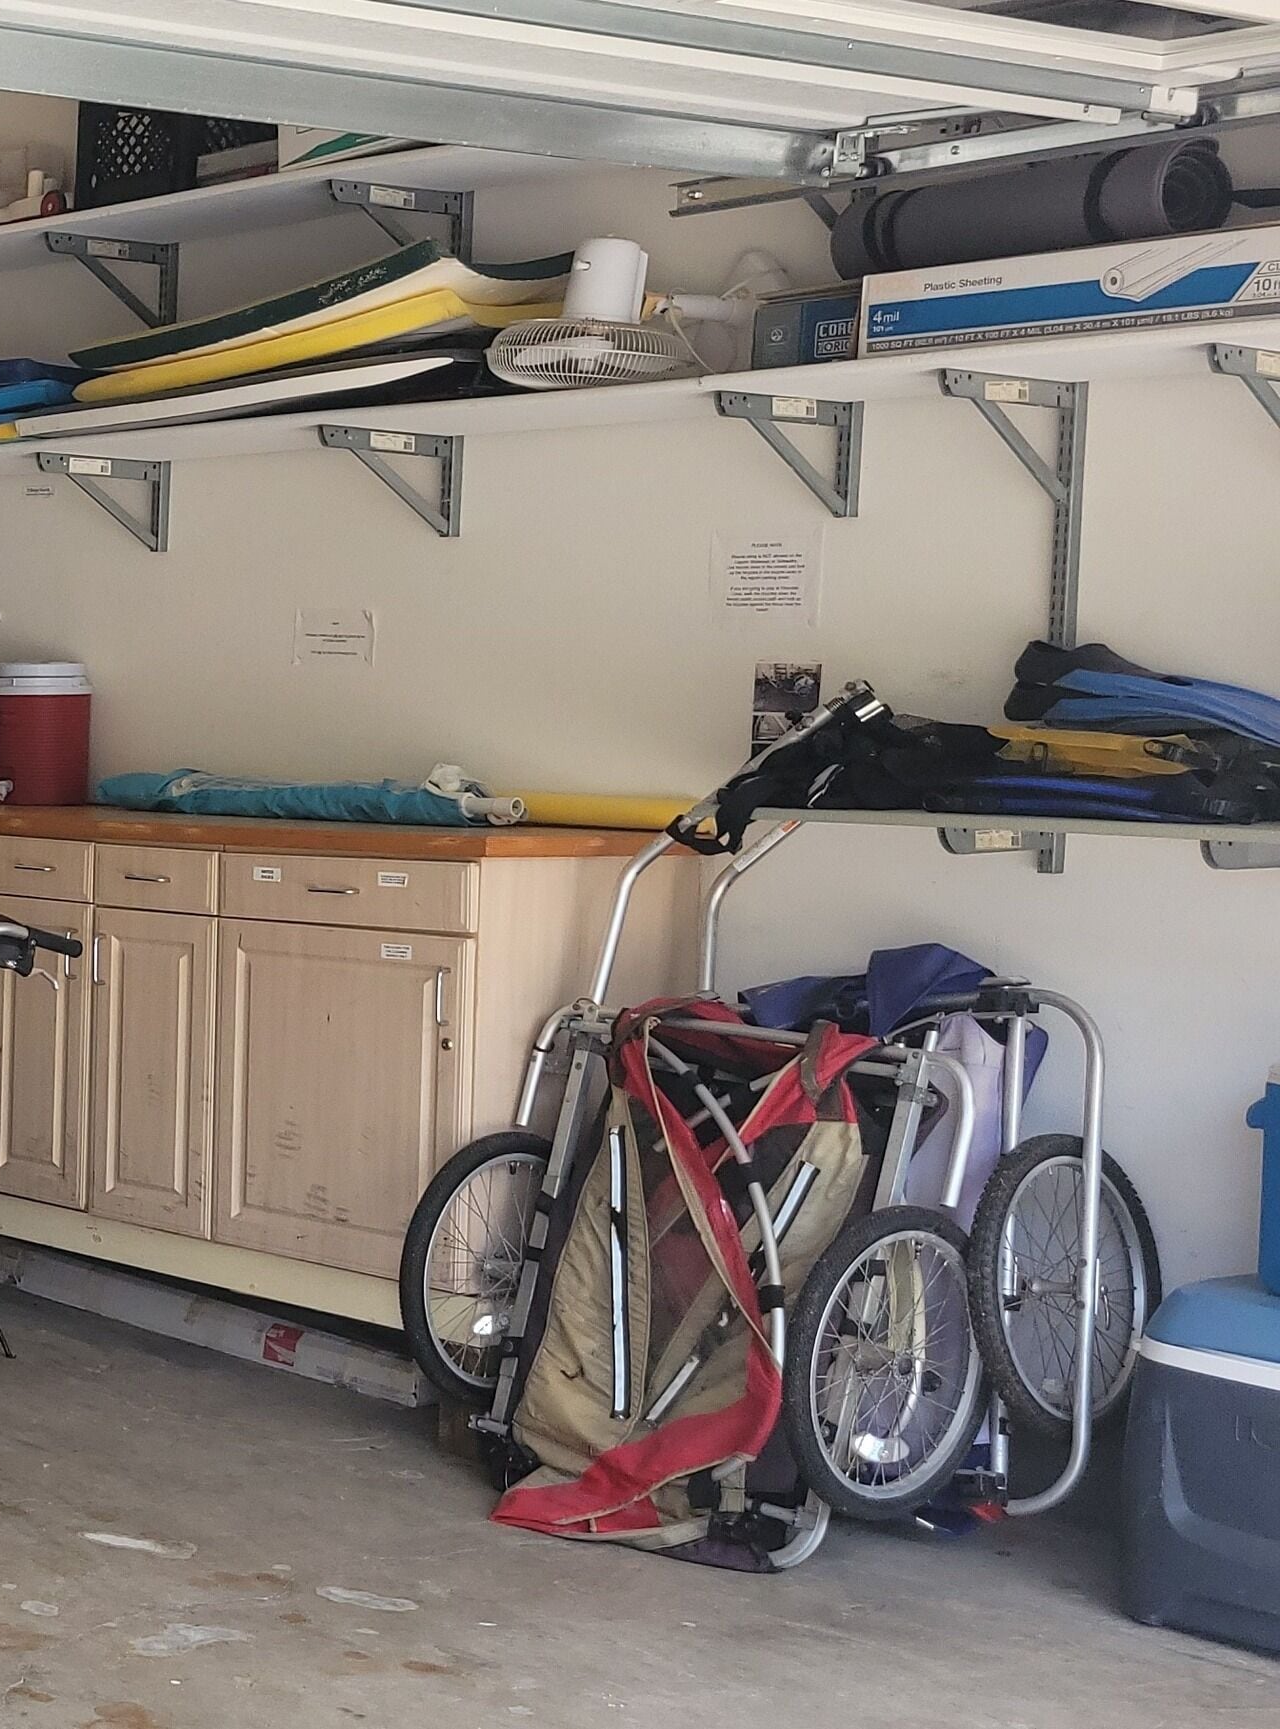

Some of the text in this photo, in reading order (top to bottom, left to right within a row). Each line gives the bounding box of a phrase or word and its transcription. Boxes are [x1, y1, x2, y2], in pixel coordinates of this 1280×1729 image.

[923, 276, 1003, 292] Plastic Sheeting
[1253, 278, 1271, 292] 10
[872, 310, 900, 323] 4 mil
[871, 341, 890, 351] 1000
[890, 340, 902, 349] SQ
[903, 339, 913, 348] FT
[965, 334, 975, 343] FT
[976, 333, 983, 341] X
[1011, 329, 1018, 337] X
[1027, 326, 1042, 336] MIL
